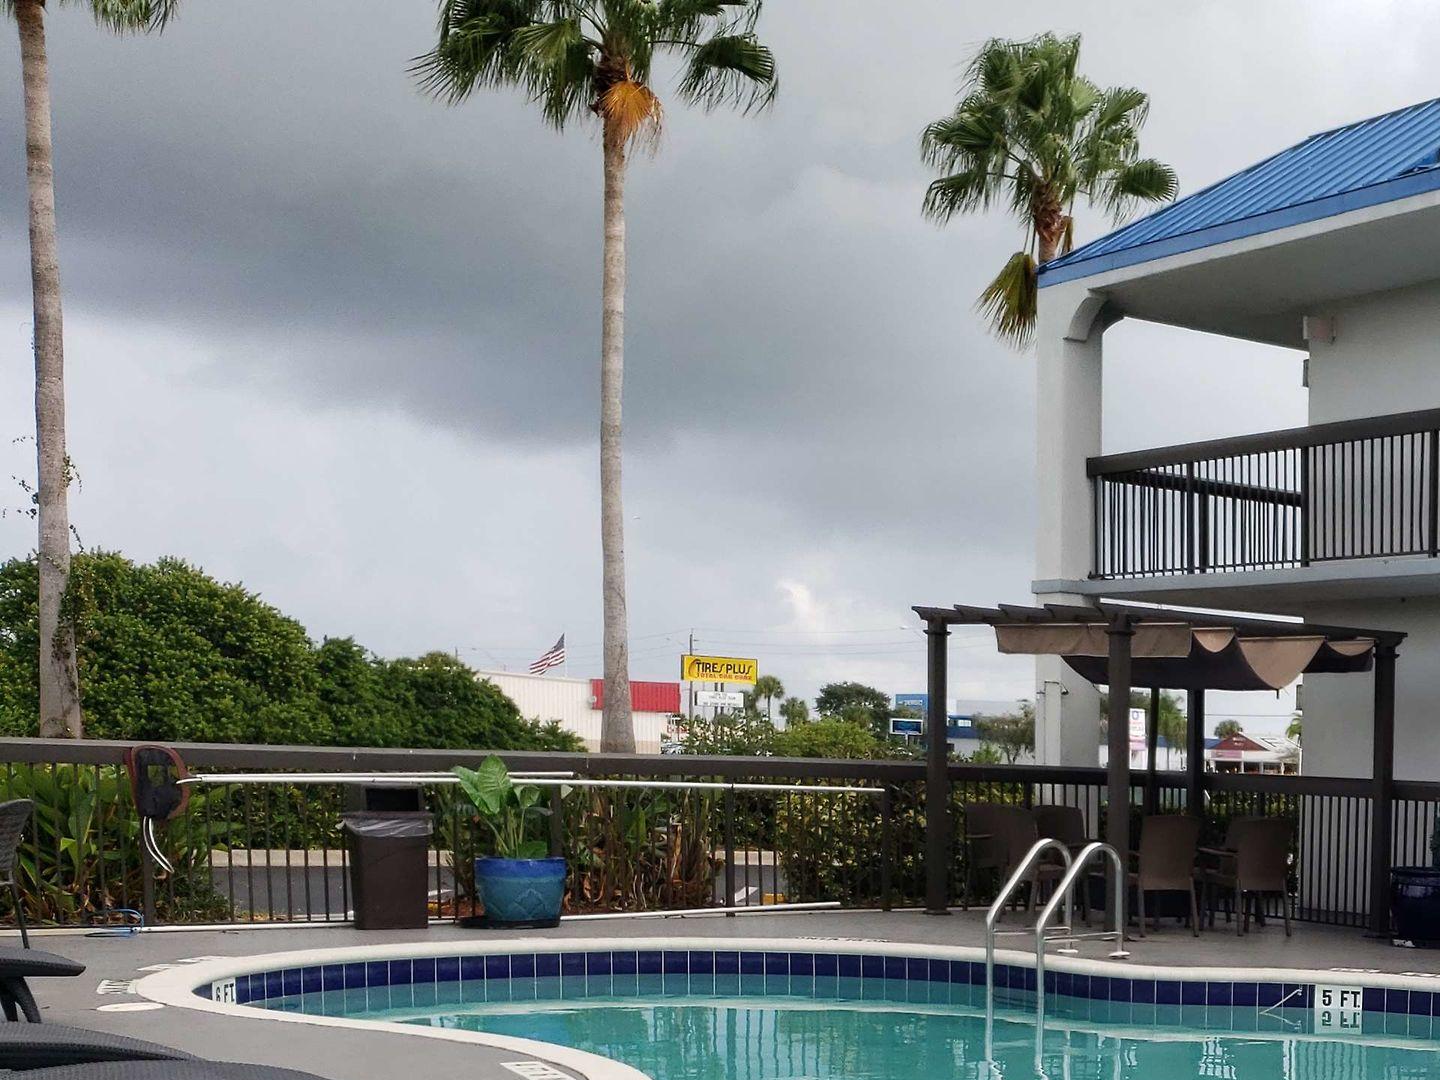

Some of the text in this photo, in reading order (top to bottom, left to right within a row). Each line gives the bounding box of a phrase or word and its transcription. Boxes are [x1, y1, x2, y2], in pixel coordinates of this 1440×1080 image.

[696, 662, 752, 675] TIRES PLUS
[1322, 989, 1361, 1008] 5 FT.
